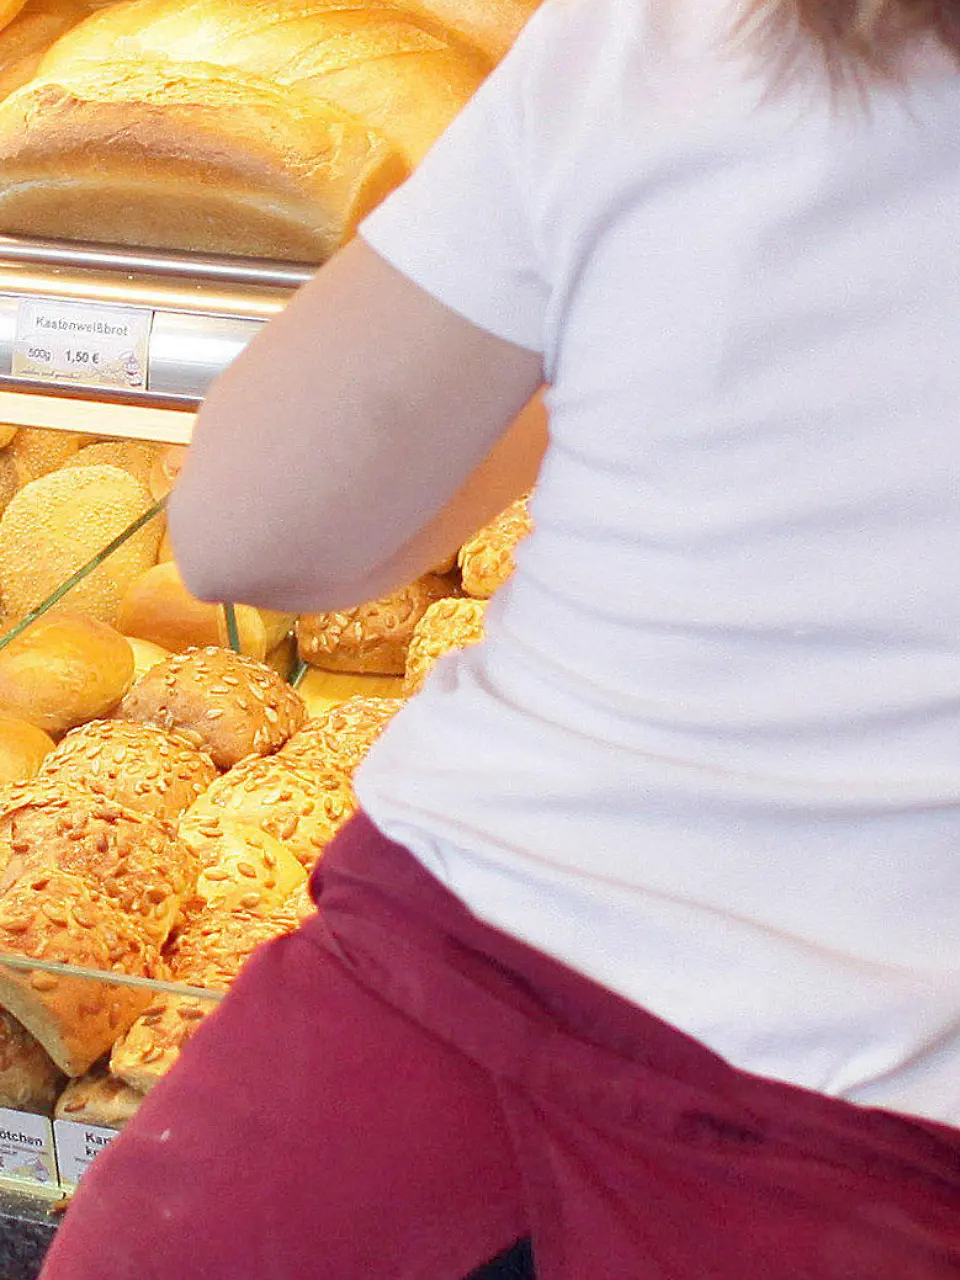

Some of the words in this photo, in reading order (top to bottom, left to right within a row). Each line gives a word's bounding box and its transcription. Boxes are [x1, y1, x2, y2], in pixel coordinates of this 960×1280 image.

[36, 316, 129, 336] Kastenweißbrot
[28, 348, 51, 362] 500g
[66, 349, 89, 363] 1,50
[92, 353, 100, 364] €
[85, 1131, 112, 1145] Kar
